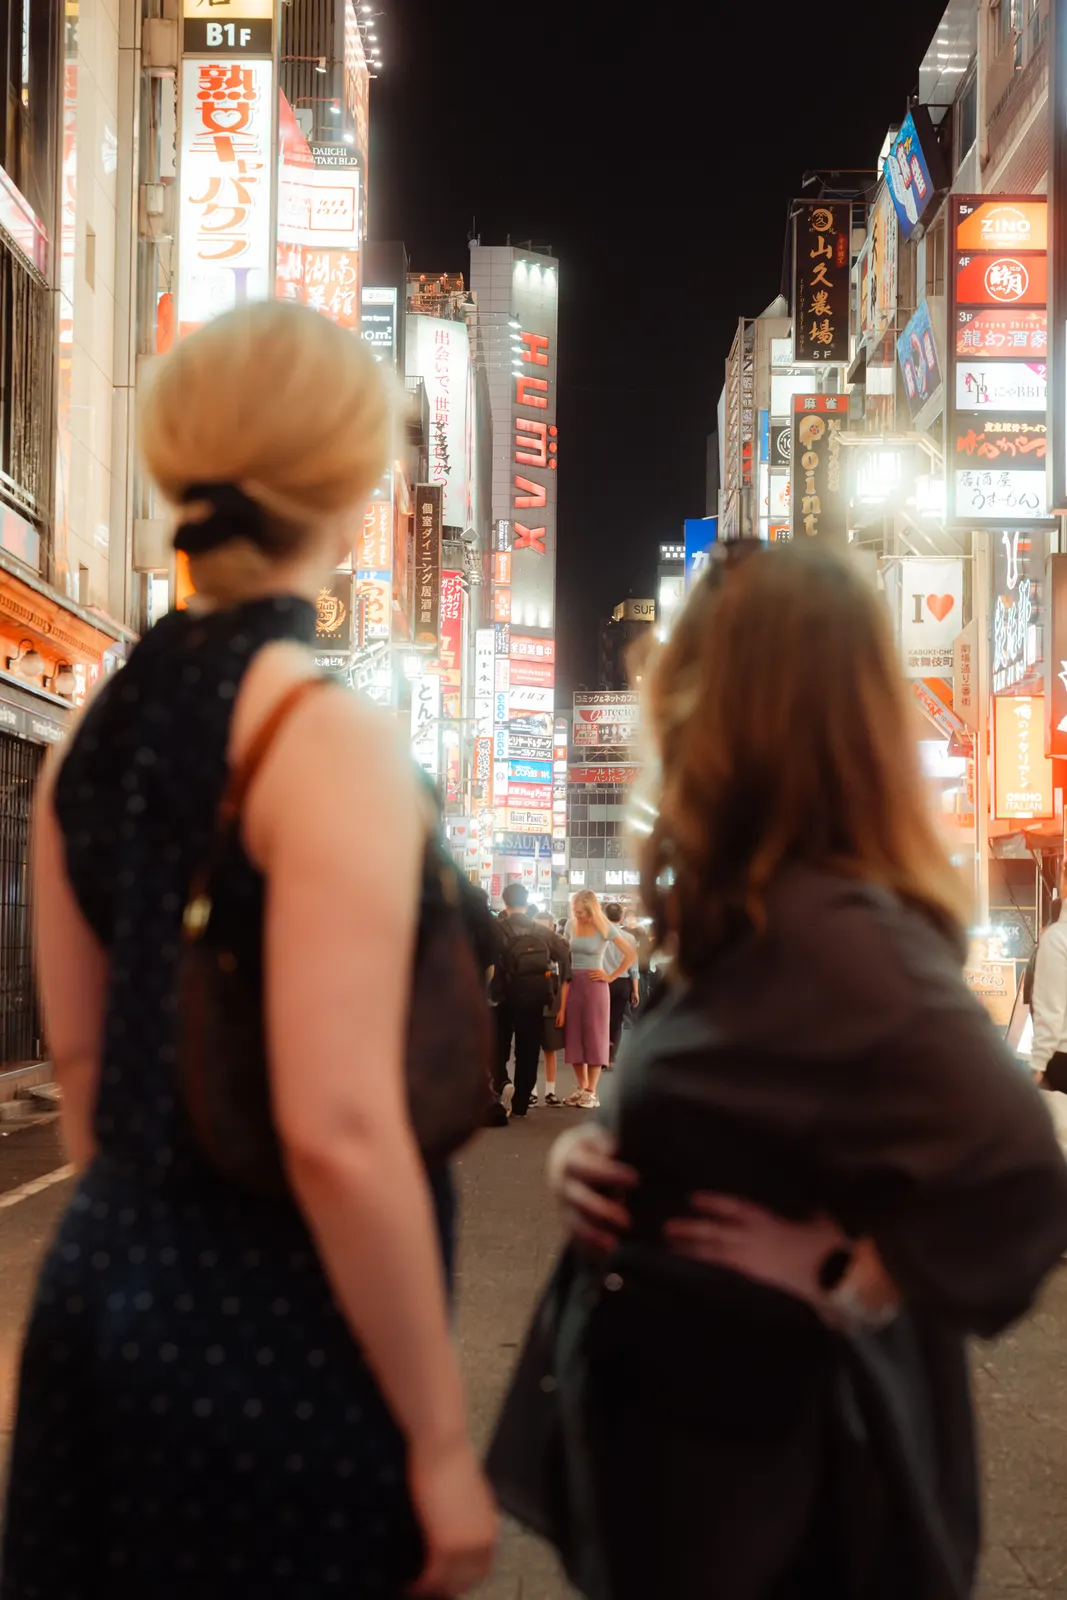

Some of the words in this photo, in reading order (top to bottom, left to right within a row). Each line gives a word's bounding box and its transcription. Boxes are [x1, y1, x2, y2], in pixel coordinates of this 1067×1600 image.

[206, 22, 251, 47] B1F
[312, 147, 347, 156] DAIICHI
[188, 64, 265, 261] 熟女キャバクラ
[313, 156, 338, 165] TAKI
[338, 157, 358, 165] BLD
[981, 219, 1030, 232] ZINO
[958, 257, 970, 266] 4F
[959, 312, 972, 322] 3F
[803, 397, 838, 411] 麻雀
[959, 471, 1012, 487] 居酒屋
[421, 502, 433, 623] 個室ダイニング居酒屋
[912, 594, 924, 623] I
[908, 656, 953, 668] 歌舞伎町
[1006, 801, 1043, 810] ITALIAN
